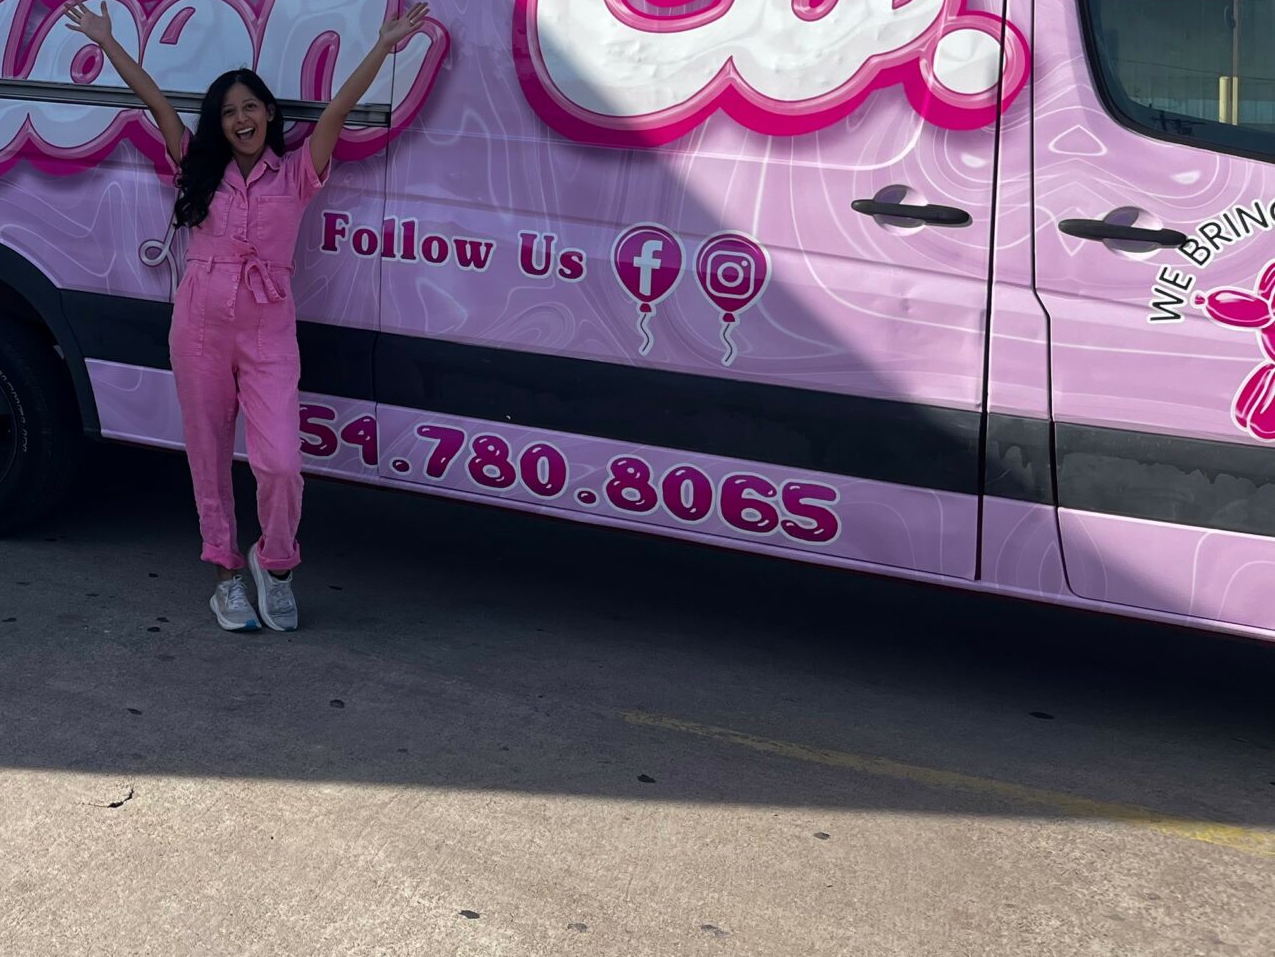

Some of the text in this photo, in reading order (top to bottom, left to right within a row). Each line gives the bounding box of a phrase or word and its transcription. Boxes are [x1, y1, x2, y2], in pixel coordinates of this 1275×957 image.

[320, 210, 587, 283] Follow Us
[1149, 266, 1194, 322] WE
[299, 401, 841, 545] 54.780.8065
